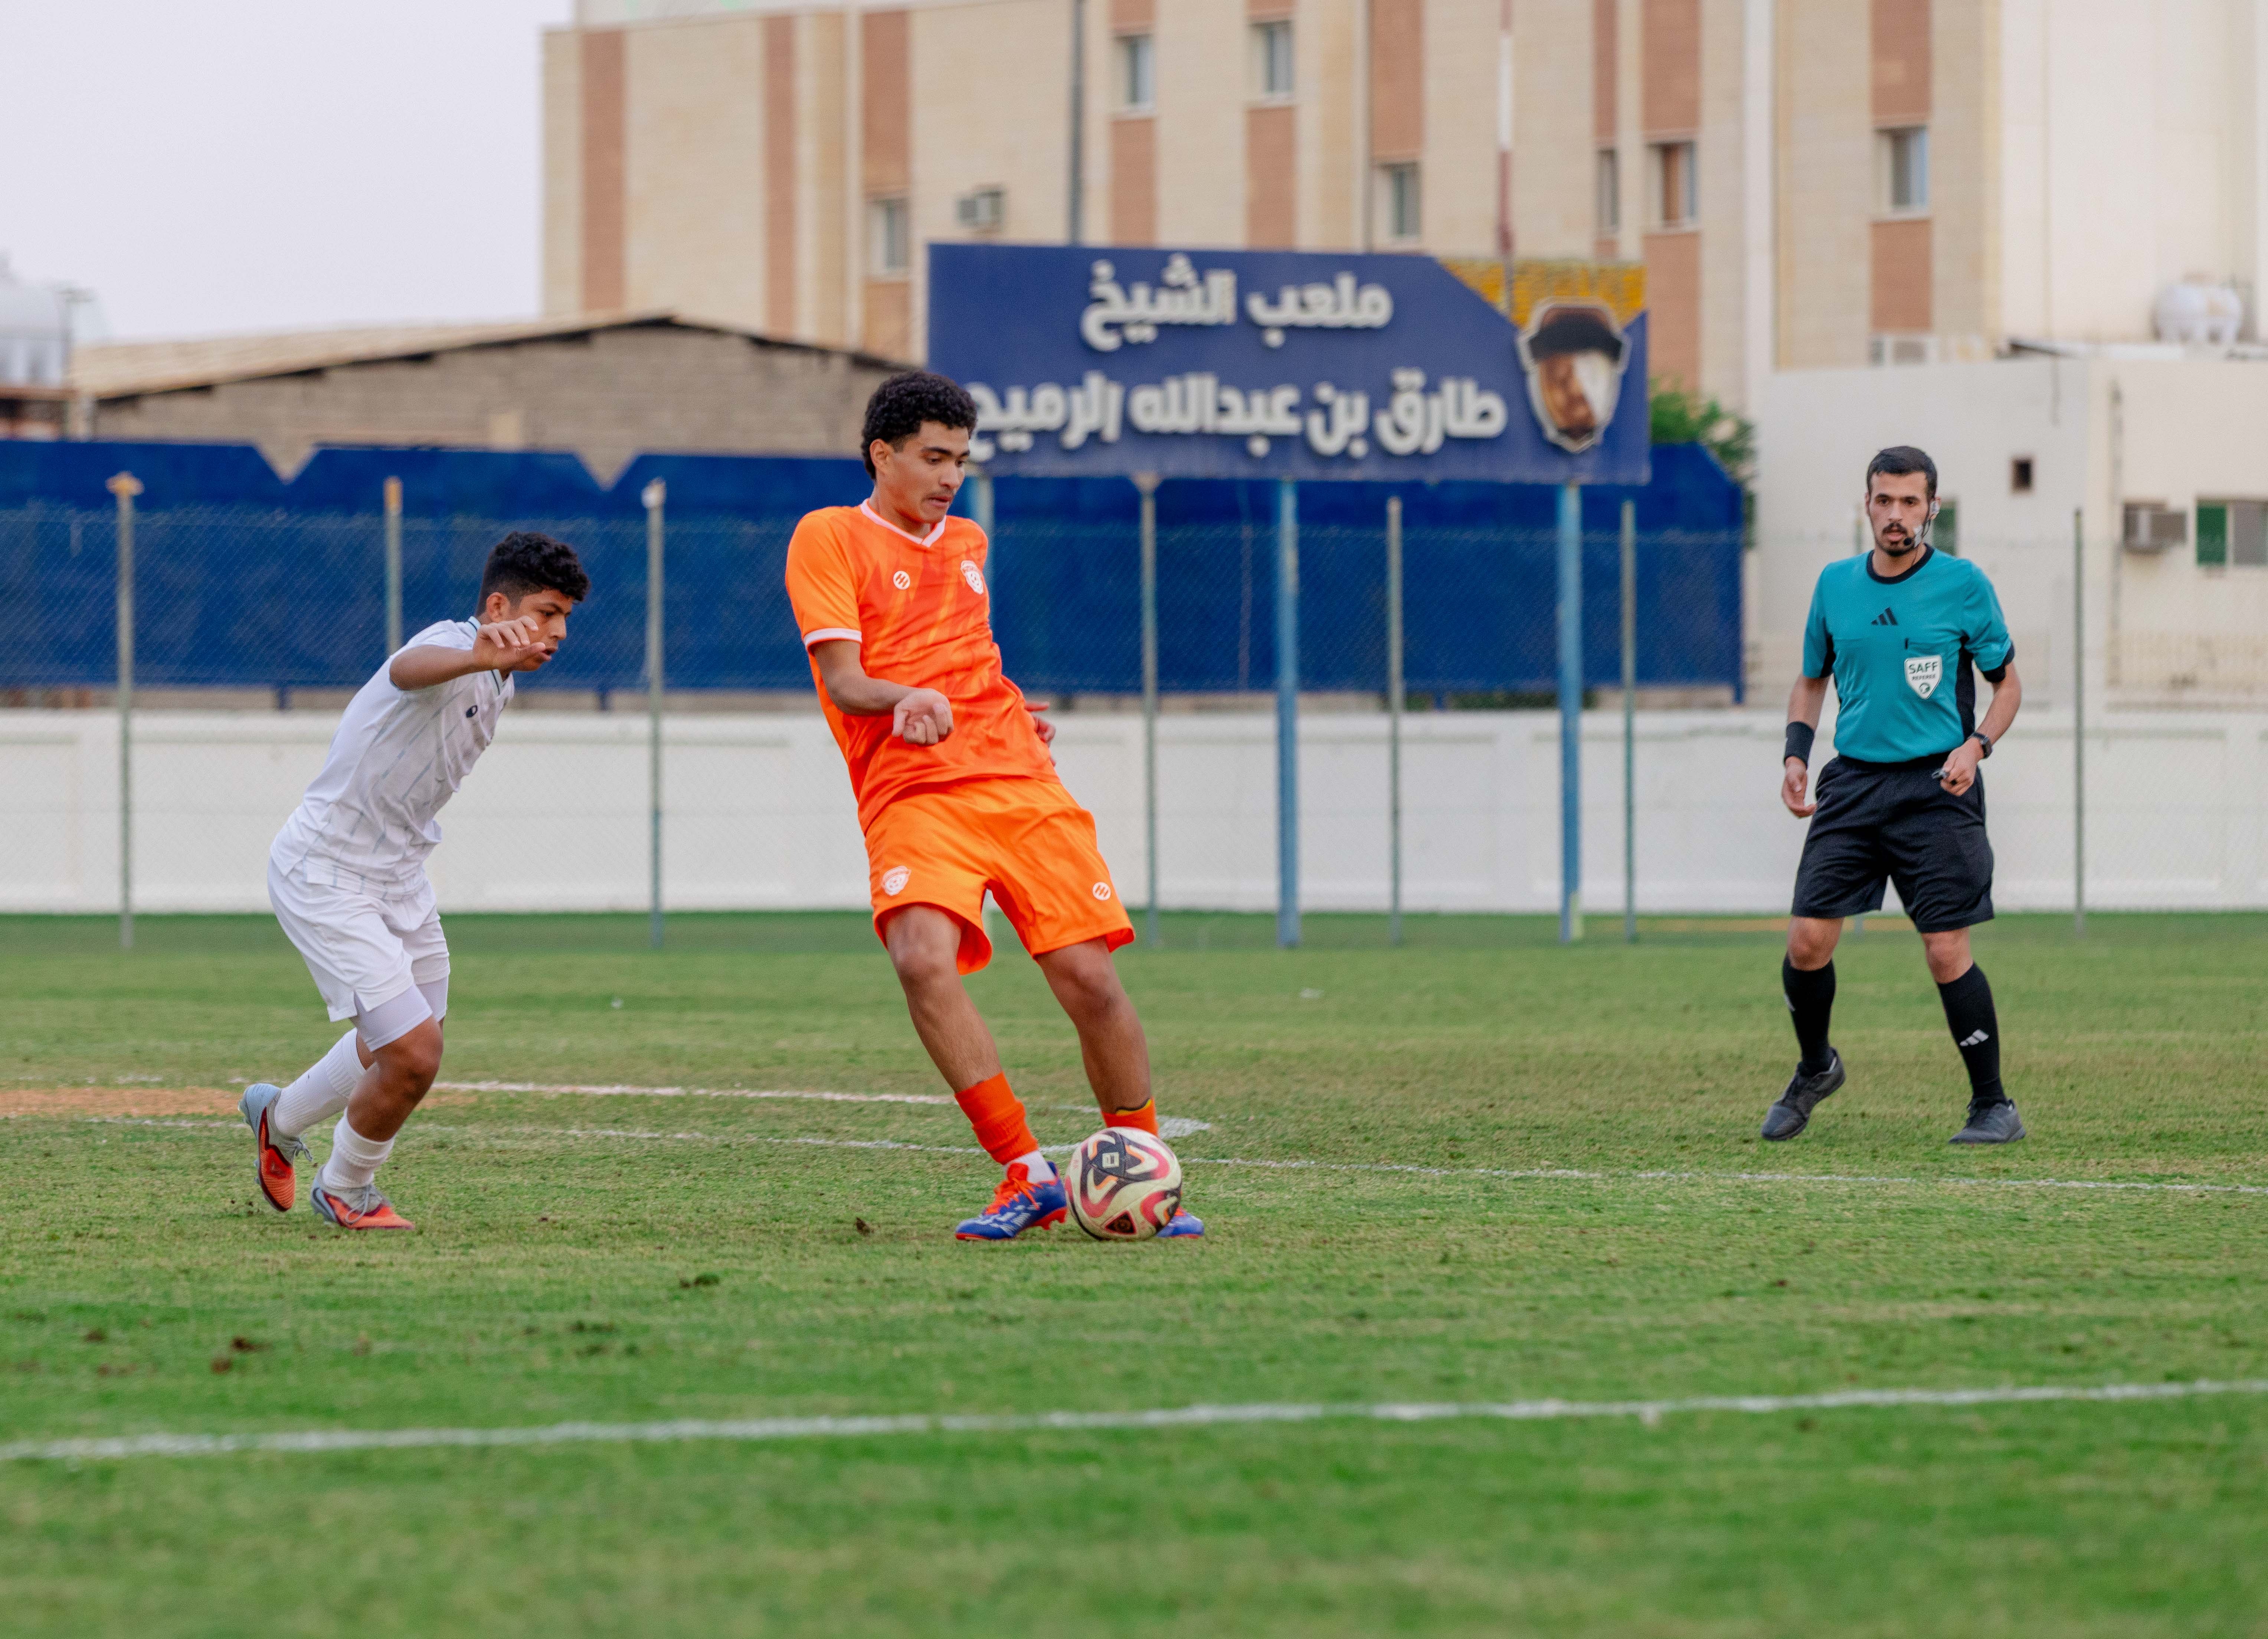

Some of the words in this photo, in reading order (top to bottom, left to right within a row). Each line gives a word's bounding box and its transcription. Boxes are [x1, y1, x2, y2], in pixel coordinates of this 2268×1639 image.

[1081, 252, 1237, 352] الشيخ
[1246, 271, 1392, 348] ملعب
[1306, 381, 1369, 458] بن
[1375, 368, 1507, 455] طارق
[1909, 661, 1938, 674] SAFF
